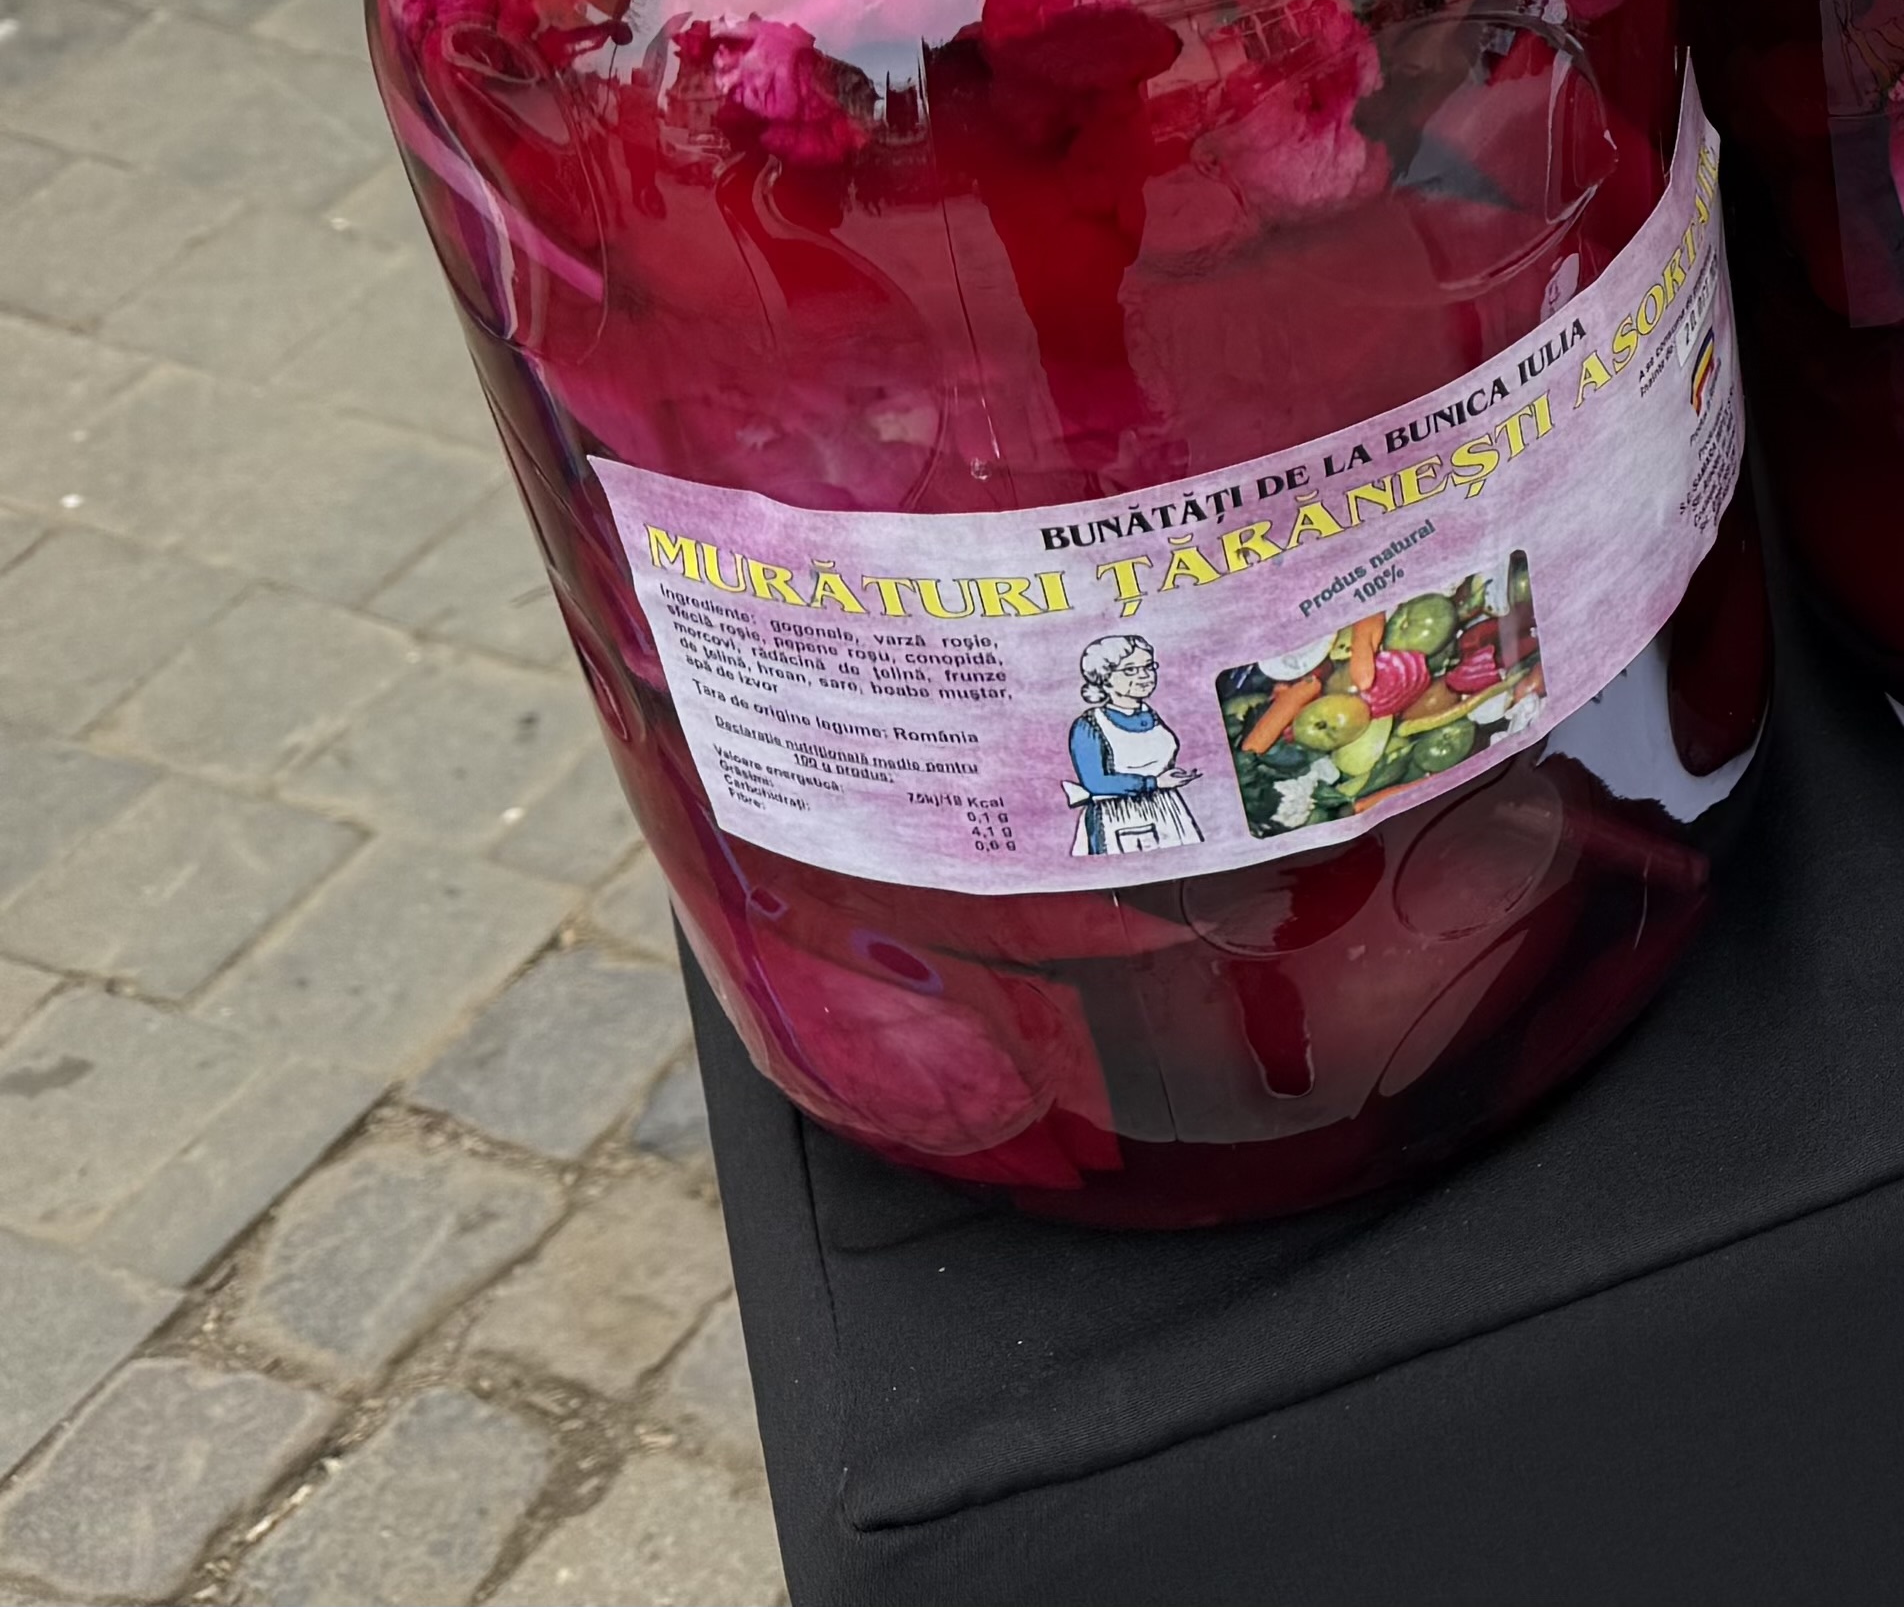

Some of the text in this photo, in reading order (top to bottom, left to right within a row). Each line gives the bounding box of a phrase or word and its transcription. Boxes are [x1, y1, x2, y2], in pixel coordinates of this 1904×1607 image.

[1041, 317, 1587, 551] BUNĂTĂȚI DE LA BUNICA IULIA
[644, 523, 1071, 618] MURĂTURI
[1097, 391, 1556, 618] ȚĂRĂNEȘTI
[1297, 519, 1438, 619] Produs natural
[1353, 563, 1406, 606] 100%
[660, 583, 926, 647] Ingrediente: gogonele, varză
[667, 604, 1003, 668] sfeclă pepene conopidă,
[673, 621, 1006, 683] morcovi, rădăcină de frunze
[680, 636, 697, 652] de
[757, 661, 812, 687] hrean,
[871, 681, 930, 699] boabe
[685, 654, 778, 693] apă de izvor
[730, 693, 979, 744] de origine legume: România
[713, 743, 762, 770] Valoare
[967, 796, 1004, 809] Kcal
[972, 826, 994, 838] 4,1
